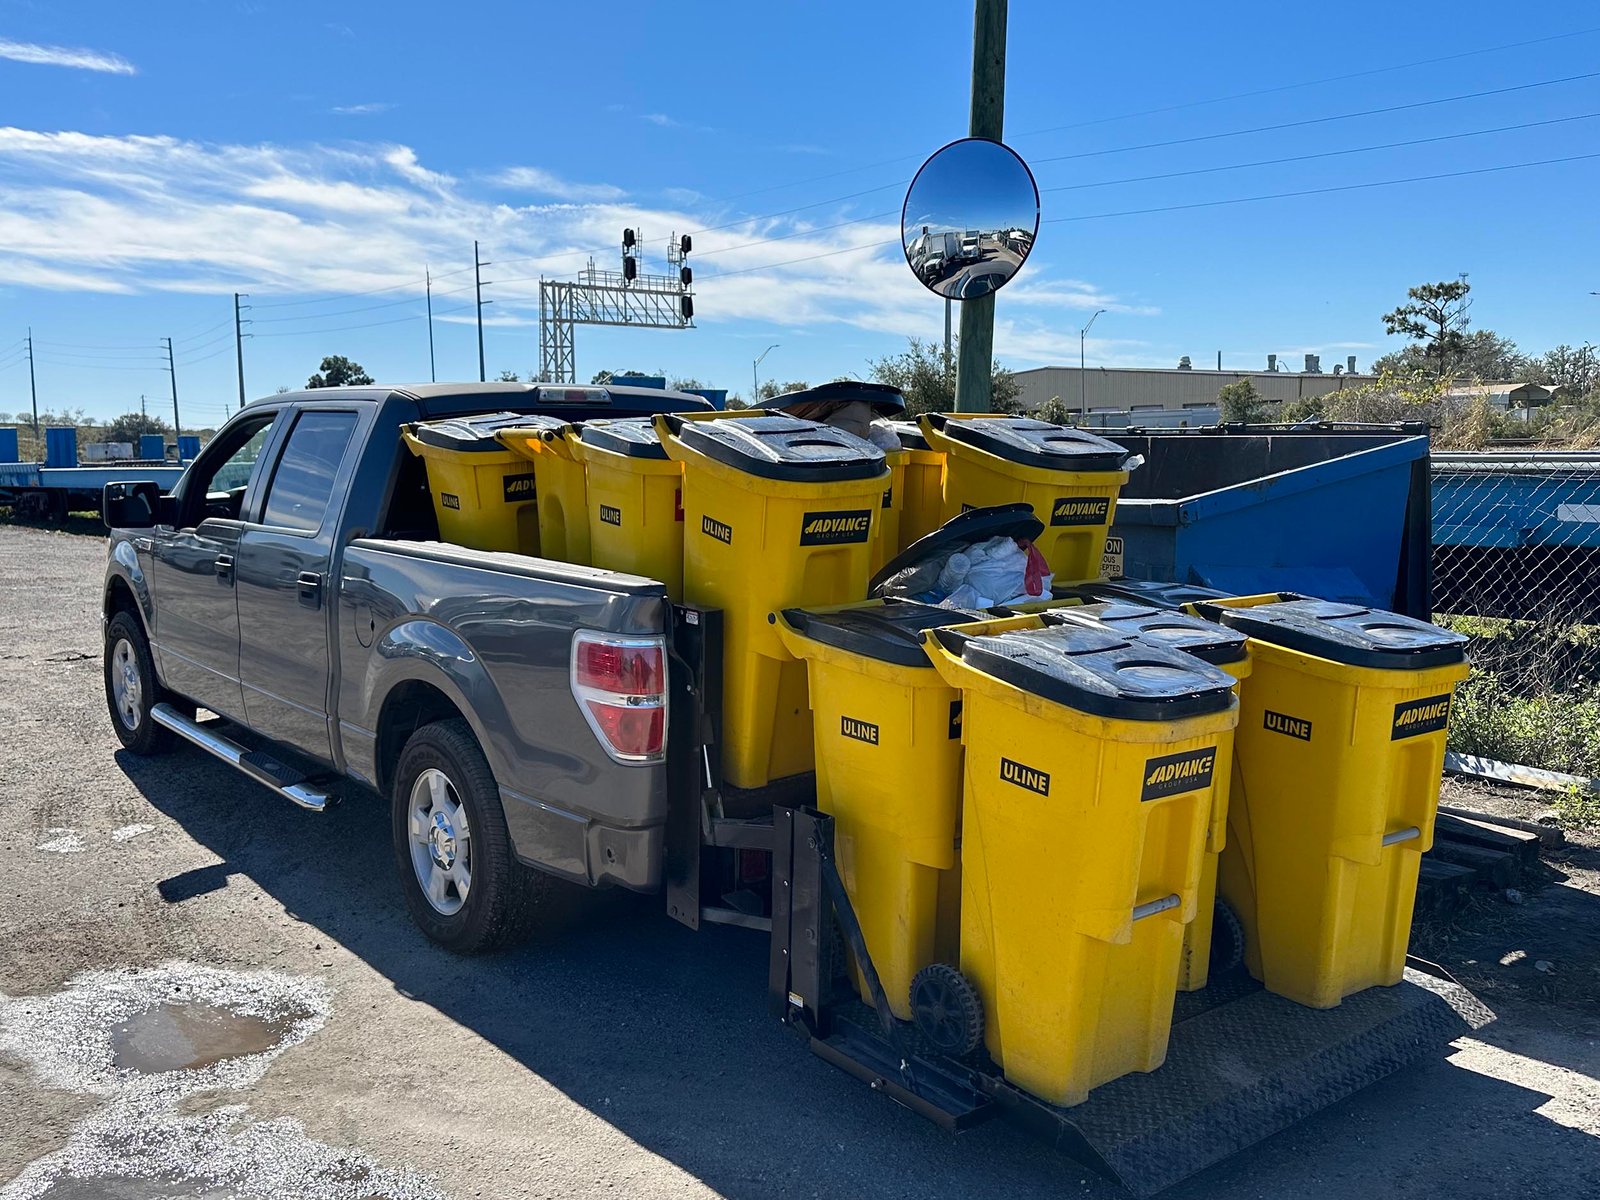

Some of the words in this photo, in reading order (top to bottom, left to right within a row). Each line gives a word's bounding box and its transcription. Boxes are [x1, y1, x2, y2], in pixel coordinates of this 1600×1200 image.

[515, 479, 536, 491] ADV
[442, 494, 459, 508] ULINE
[601, 508, 620, 523] ULINE
[1062, 502, 1107, 516] ADVANCE
[703, 518, 730, 541] ULINE
[813, 517, 868, 533] ADVANCE
[1105, 540, 1121, 553] ON
[1103, 555, 1116, 563] OUS
[1102, 563, 1121, 572] EPTED
[1403, 701, 1448, 725] ADVANCE
[843, 719, 877, 742] ULINE
[1266, 713, 1309, 738] ULINE
[1003, 761, 1047, 792] ULINE
[1155, 755, 1213, 784] ADVANCE
